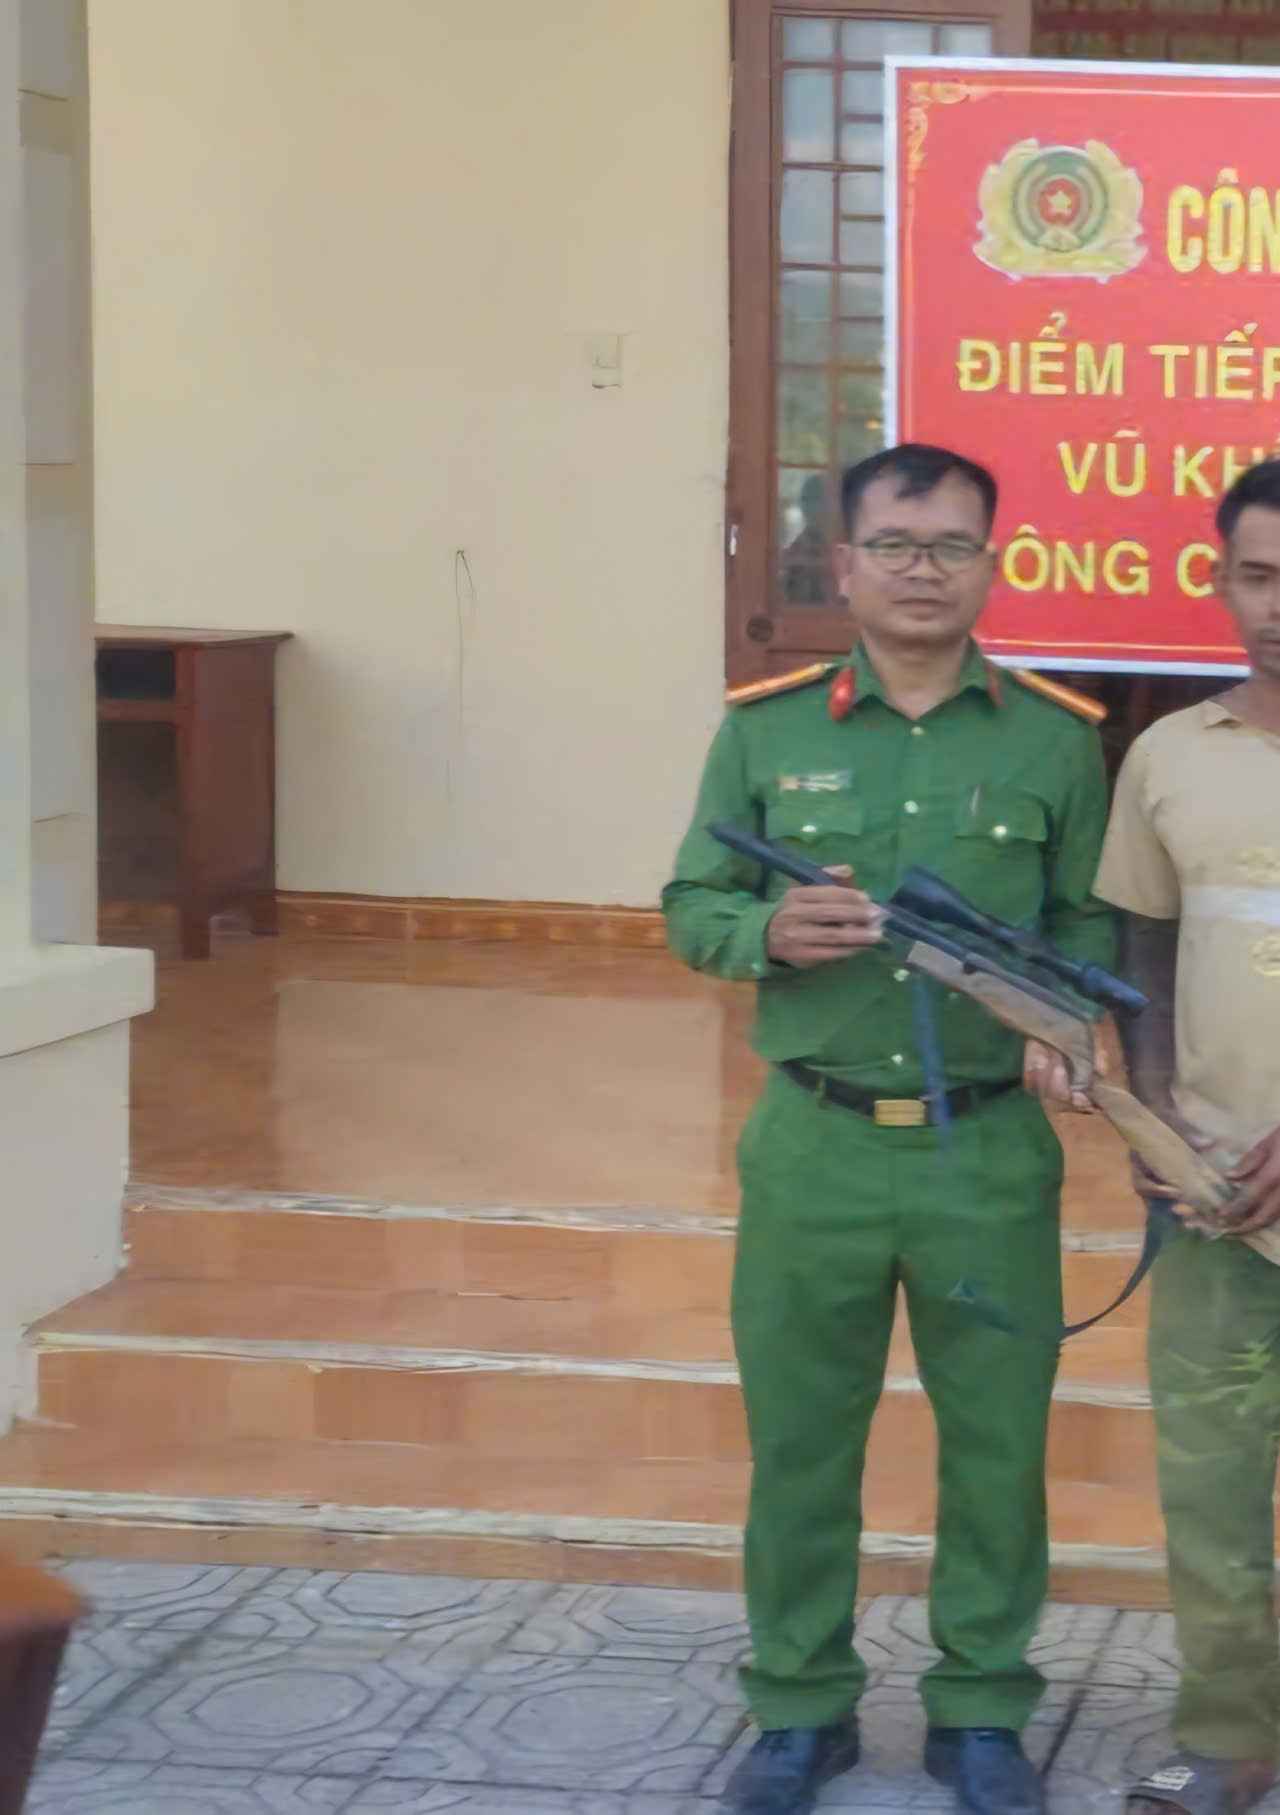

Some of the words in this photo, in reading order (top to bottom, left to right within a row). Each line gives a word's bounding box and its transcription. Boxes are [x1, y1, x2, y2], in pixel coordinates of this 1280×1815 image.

[956, 311, 1125, 397] ĐIỂM
[1057, 430, 1148, 498] VŨ
[1003, 524, 1150, 596] ÔNG
